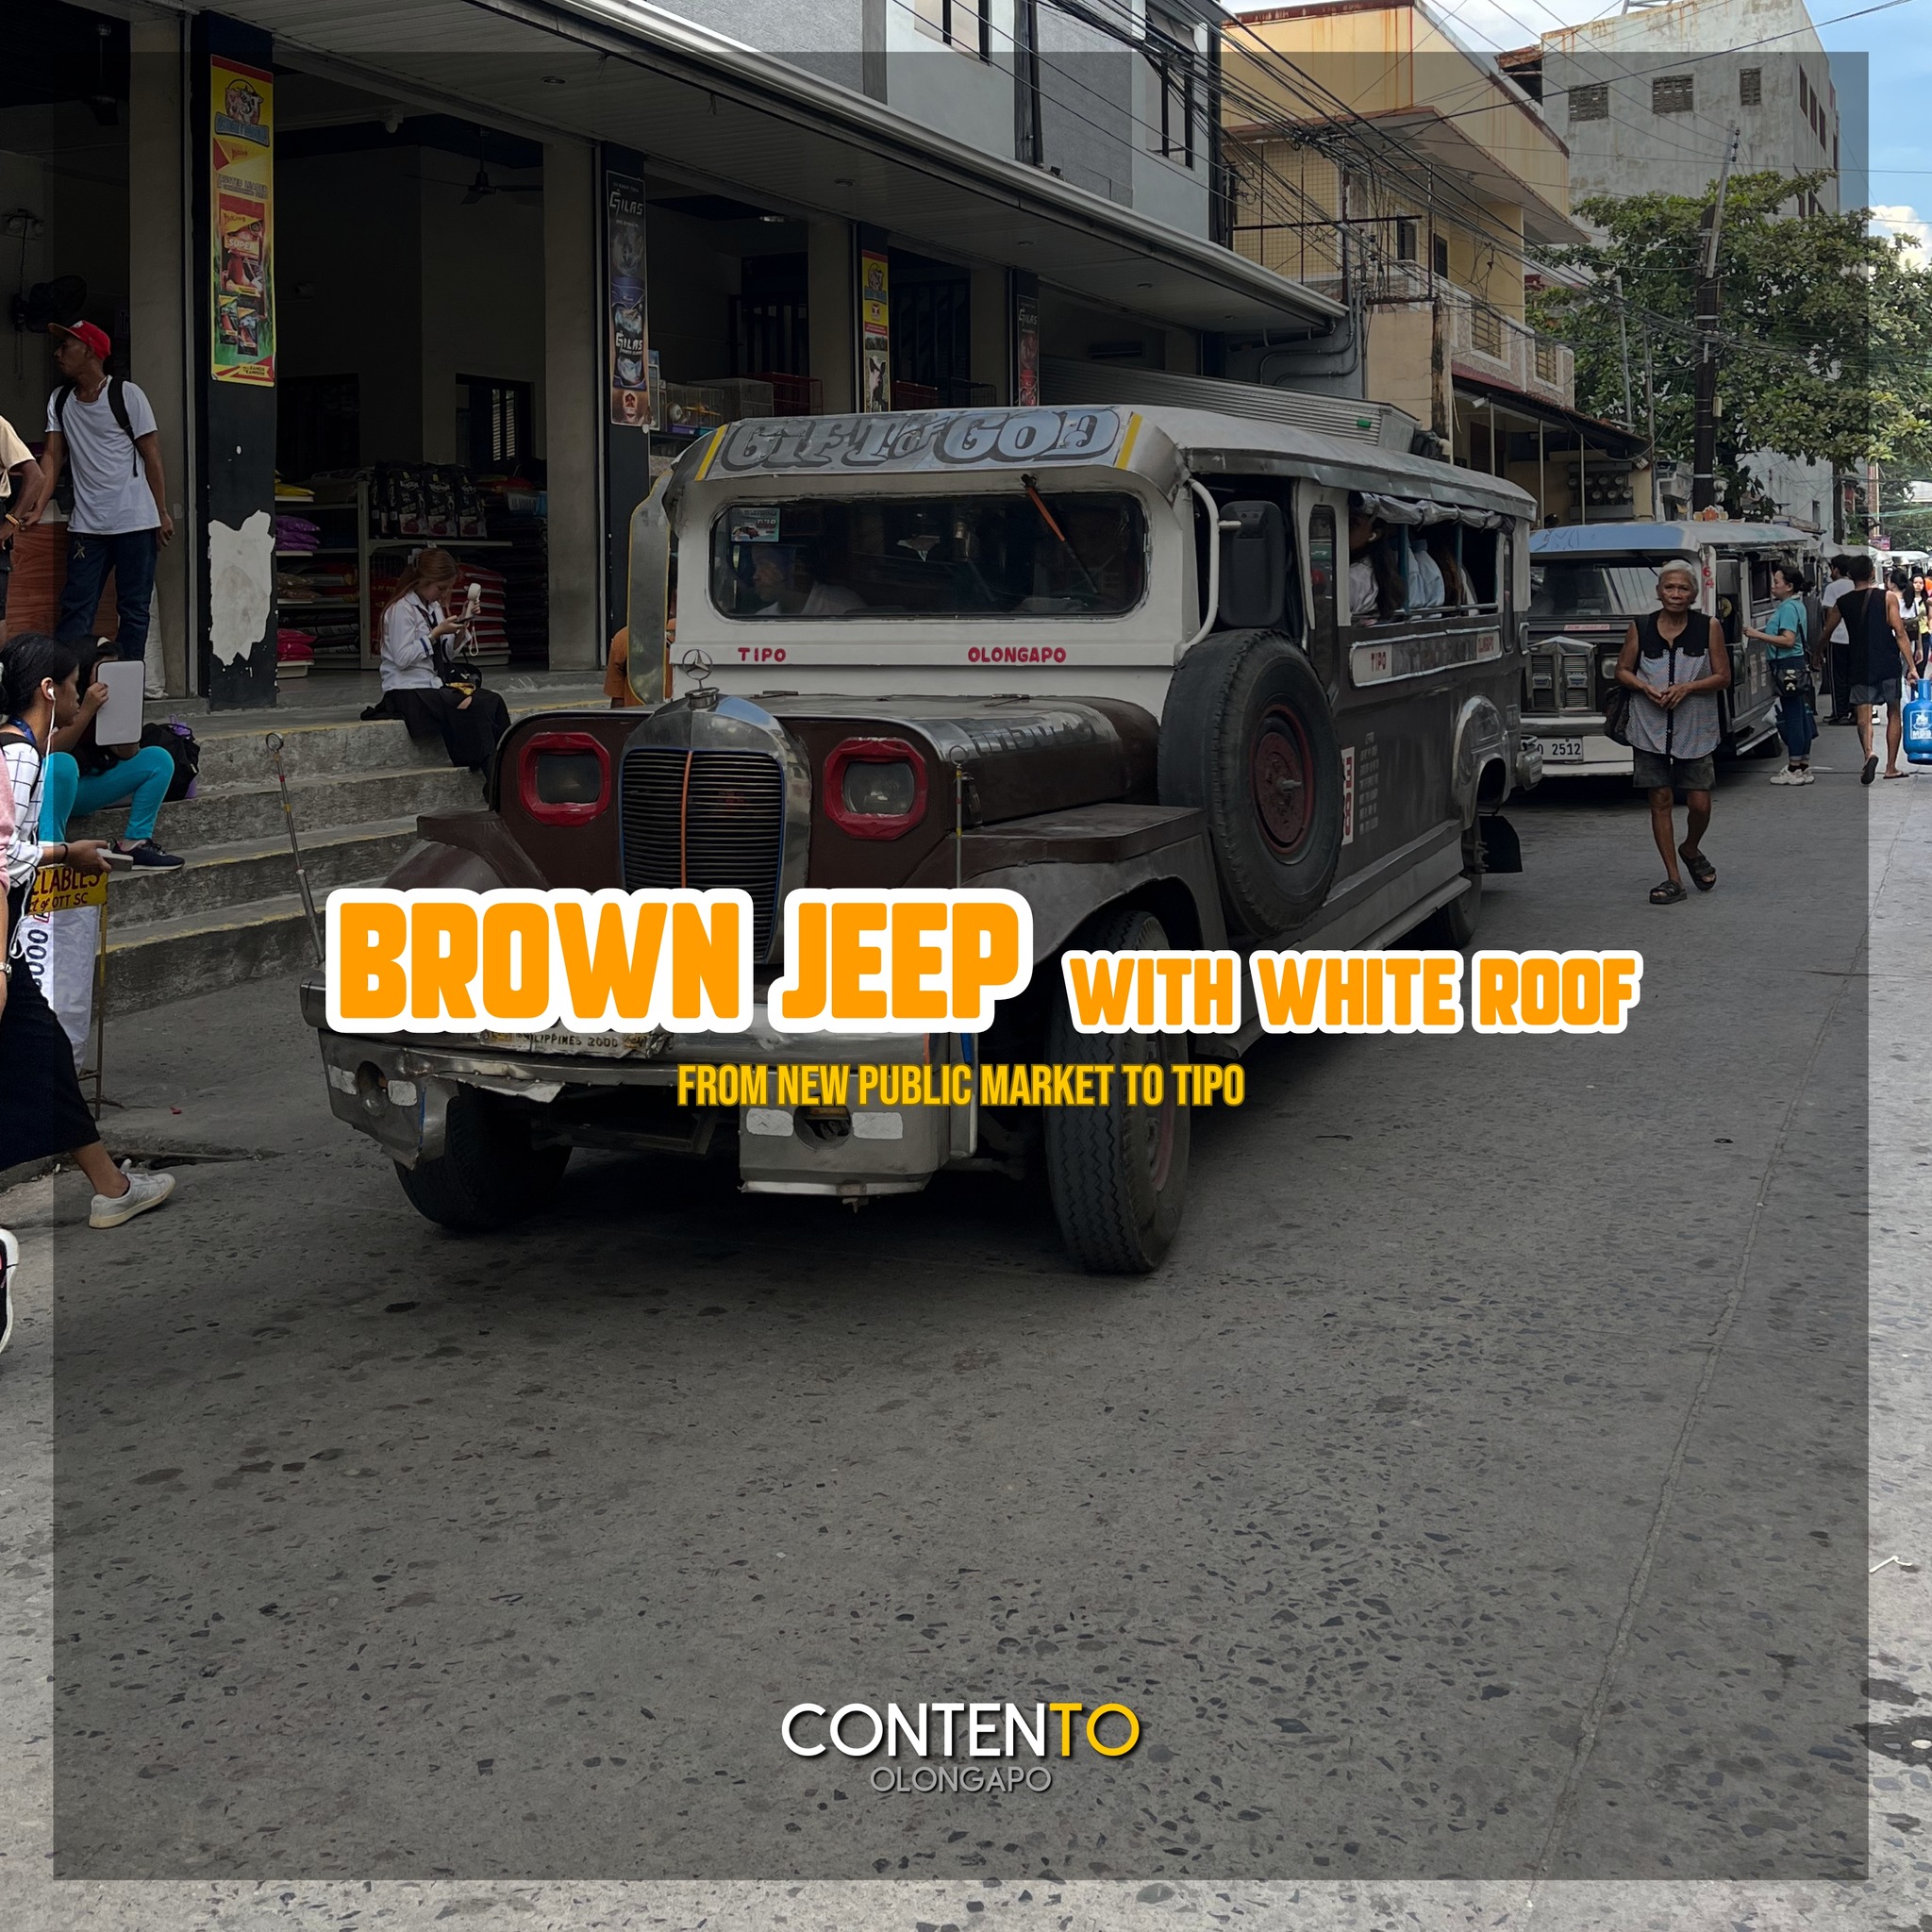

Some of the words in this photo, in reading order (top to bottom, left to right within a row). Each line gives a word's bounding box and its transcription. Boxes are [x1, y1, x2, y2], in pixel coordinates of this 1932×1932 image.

[608, 189, 643, 218] GILAS
[616, 331, 643, 353] GILAS
[723, 414, 906, 472] GIFT
[934, 408, 1123, 465] GOD
[739, 648, 786, 664] TIPO
[968, 646, 1067, 664] OLONGAPO
[1371, 651, 1387, 672] TIPO
[1552, 742, 1581, 756] 2512
[32, 867, 100, 895] LABLES
[51, 894, 71, 908] OTT
[74, 891, 89, 906] SC
